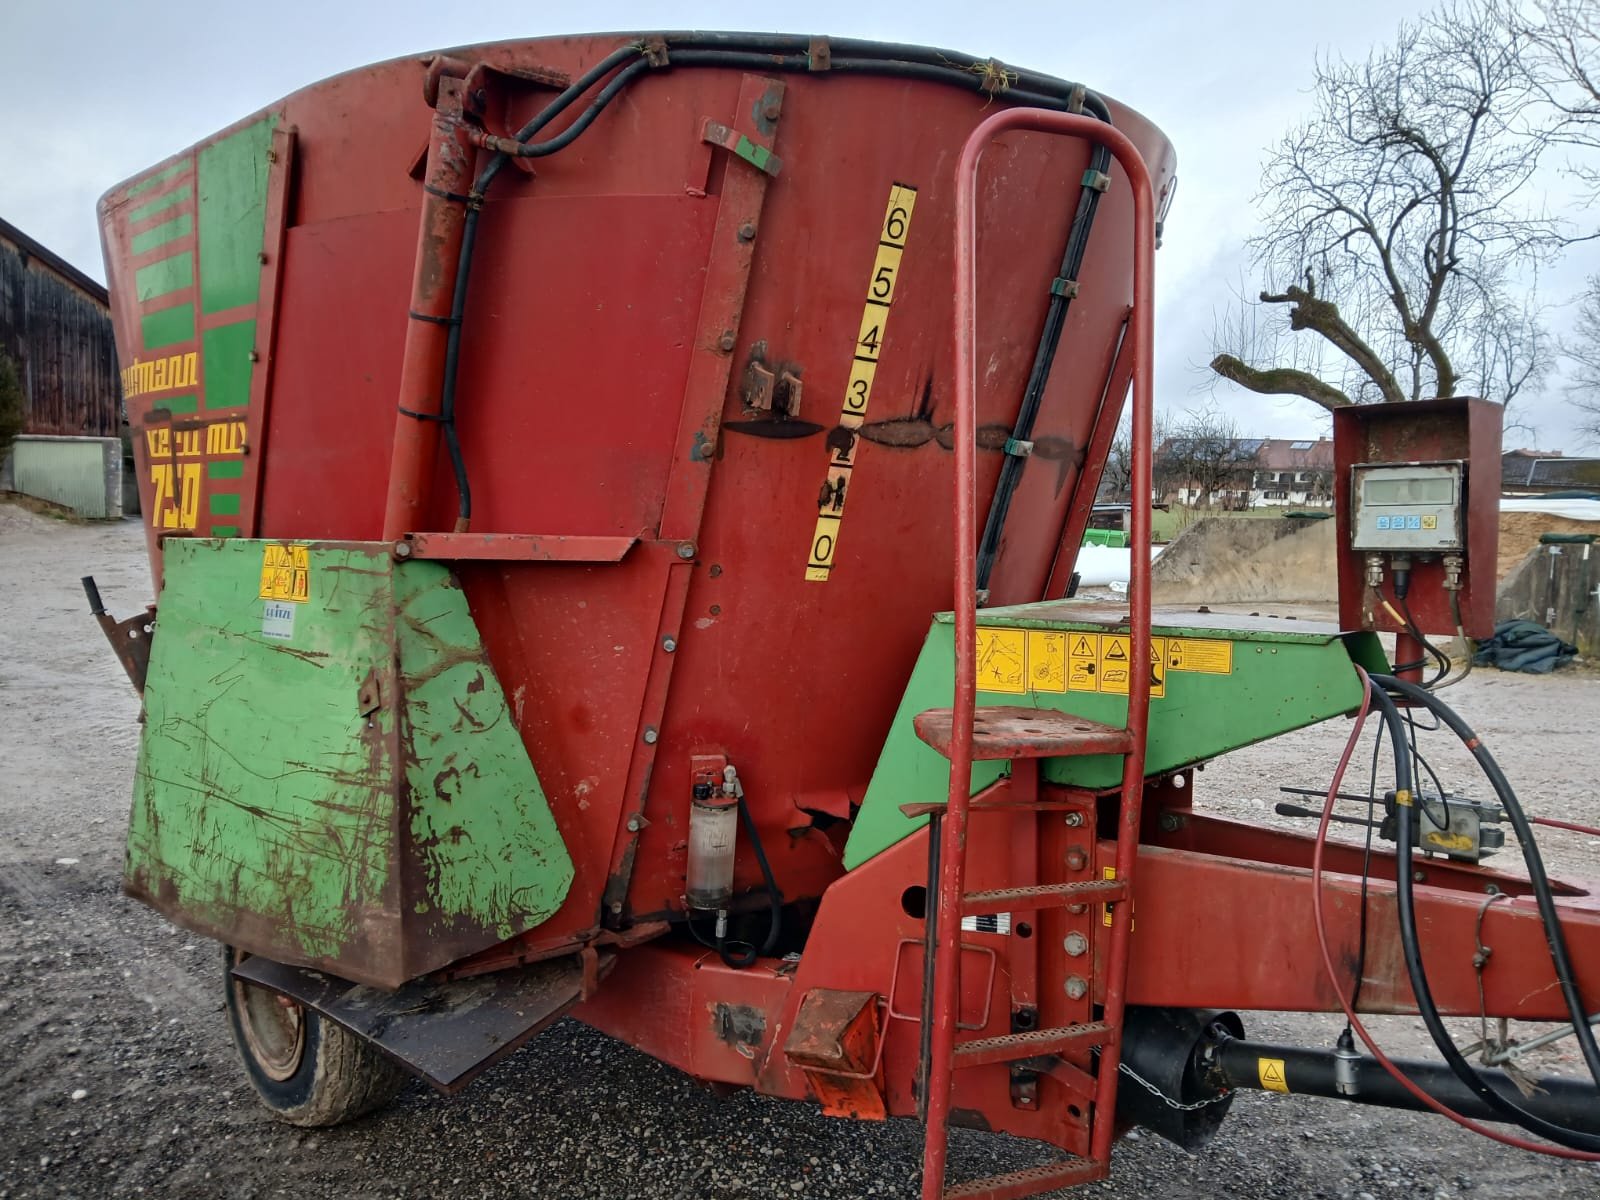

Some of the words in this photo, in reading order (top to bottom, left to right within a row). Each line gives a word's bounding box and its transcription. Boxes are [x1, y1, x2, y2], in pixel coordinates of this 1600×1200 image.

[886, 207, 907, 240] 6
[872, 266, 892, 298] 5
[860, 325, 879, 354] 4
[847, 380, 867, 409] 3
[151, 463, 202, 529] 750
[813, 534, 833, 562] 0
